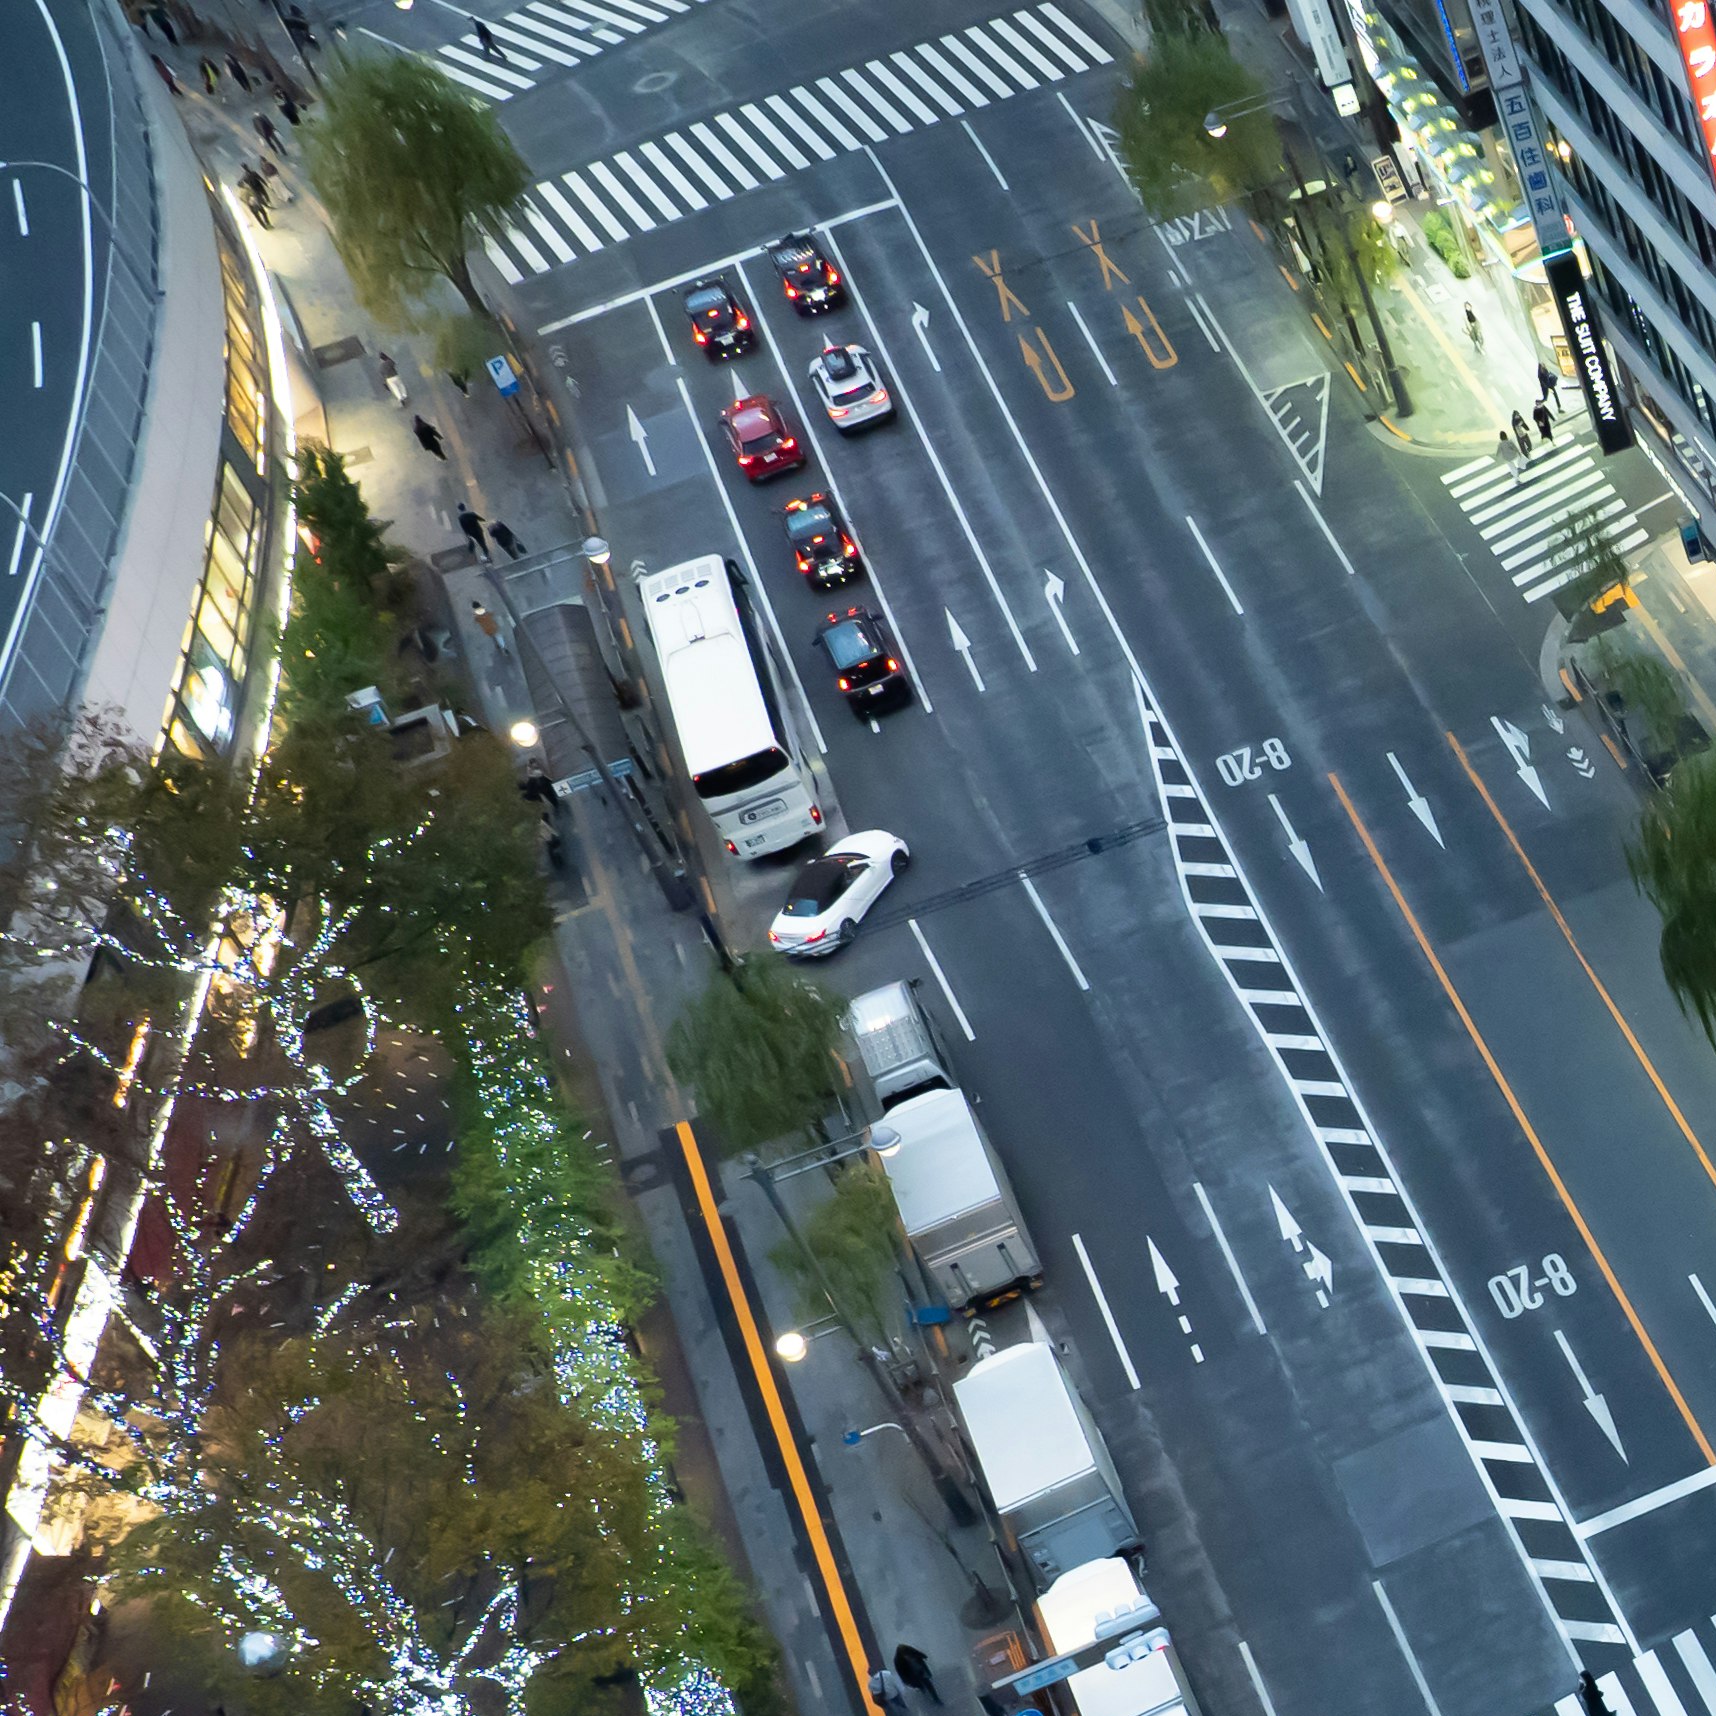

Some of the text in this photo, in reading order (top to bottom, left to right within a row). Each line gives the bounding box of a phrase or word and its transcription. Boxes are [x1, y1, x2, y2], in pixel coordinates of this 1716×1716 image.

[1566, 291, 1617, 421] THE SUIT COMPANY
[1215, 737, 1290, 788] 8-20
[1487, 1252, 1578, 1320] 8-20
